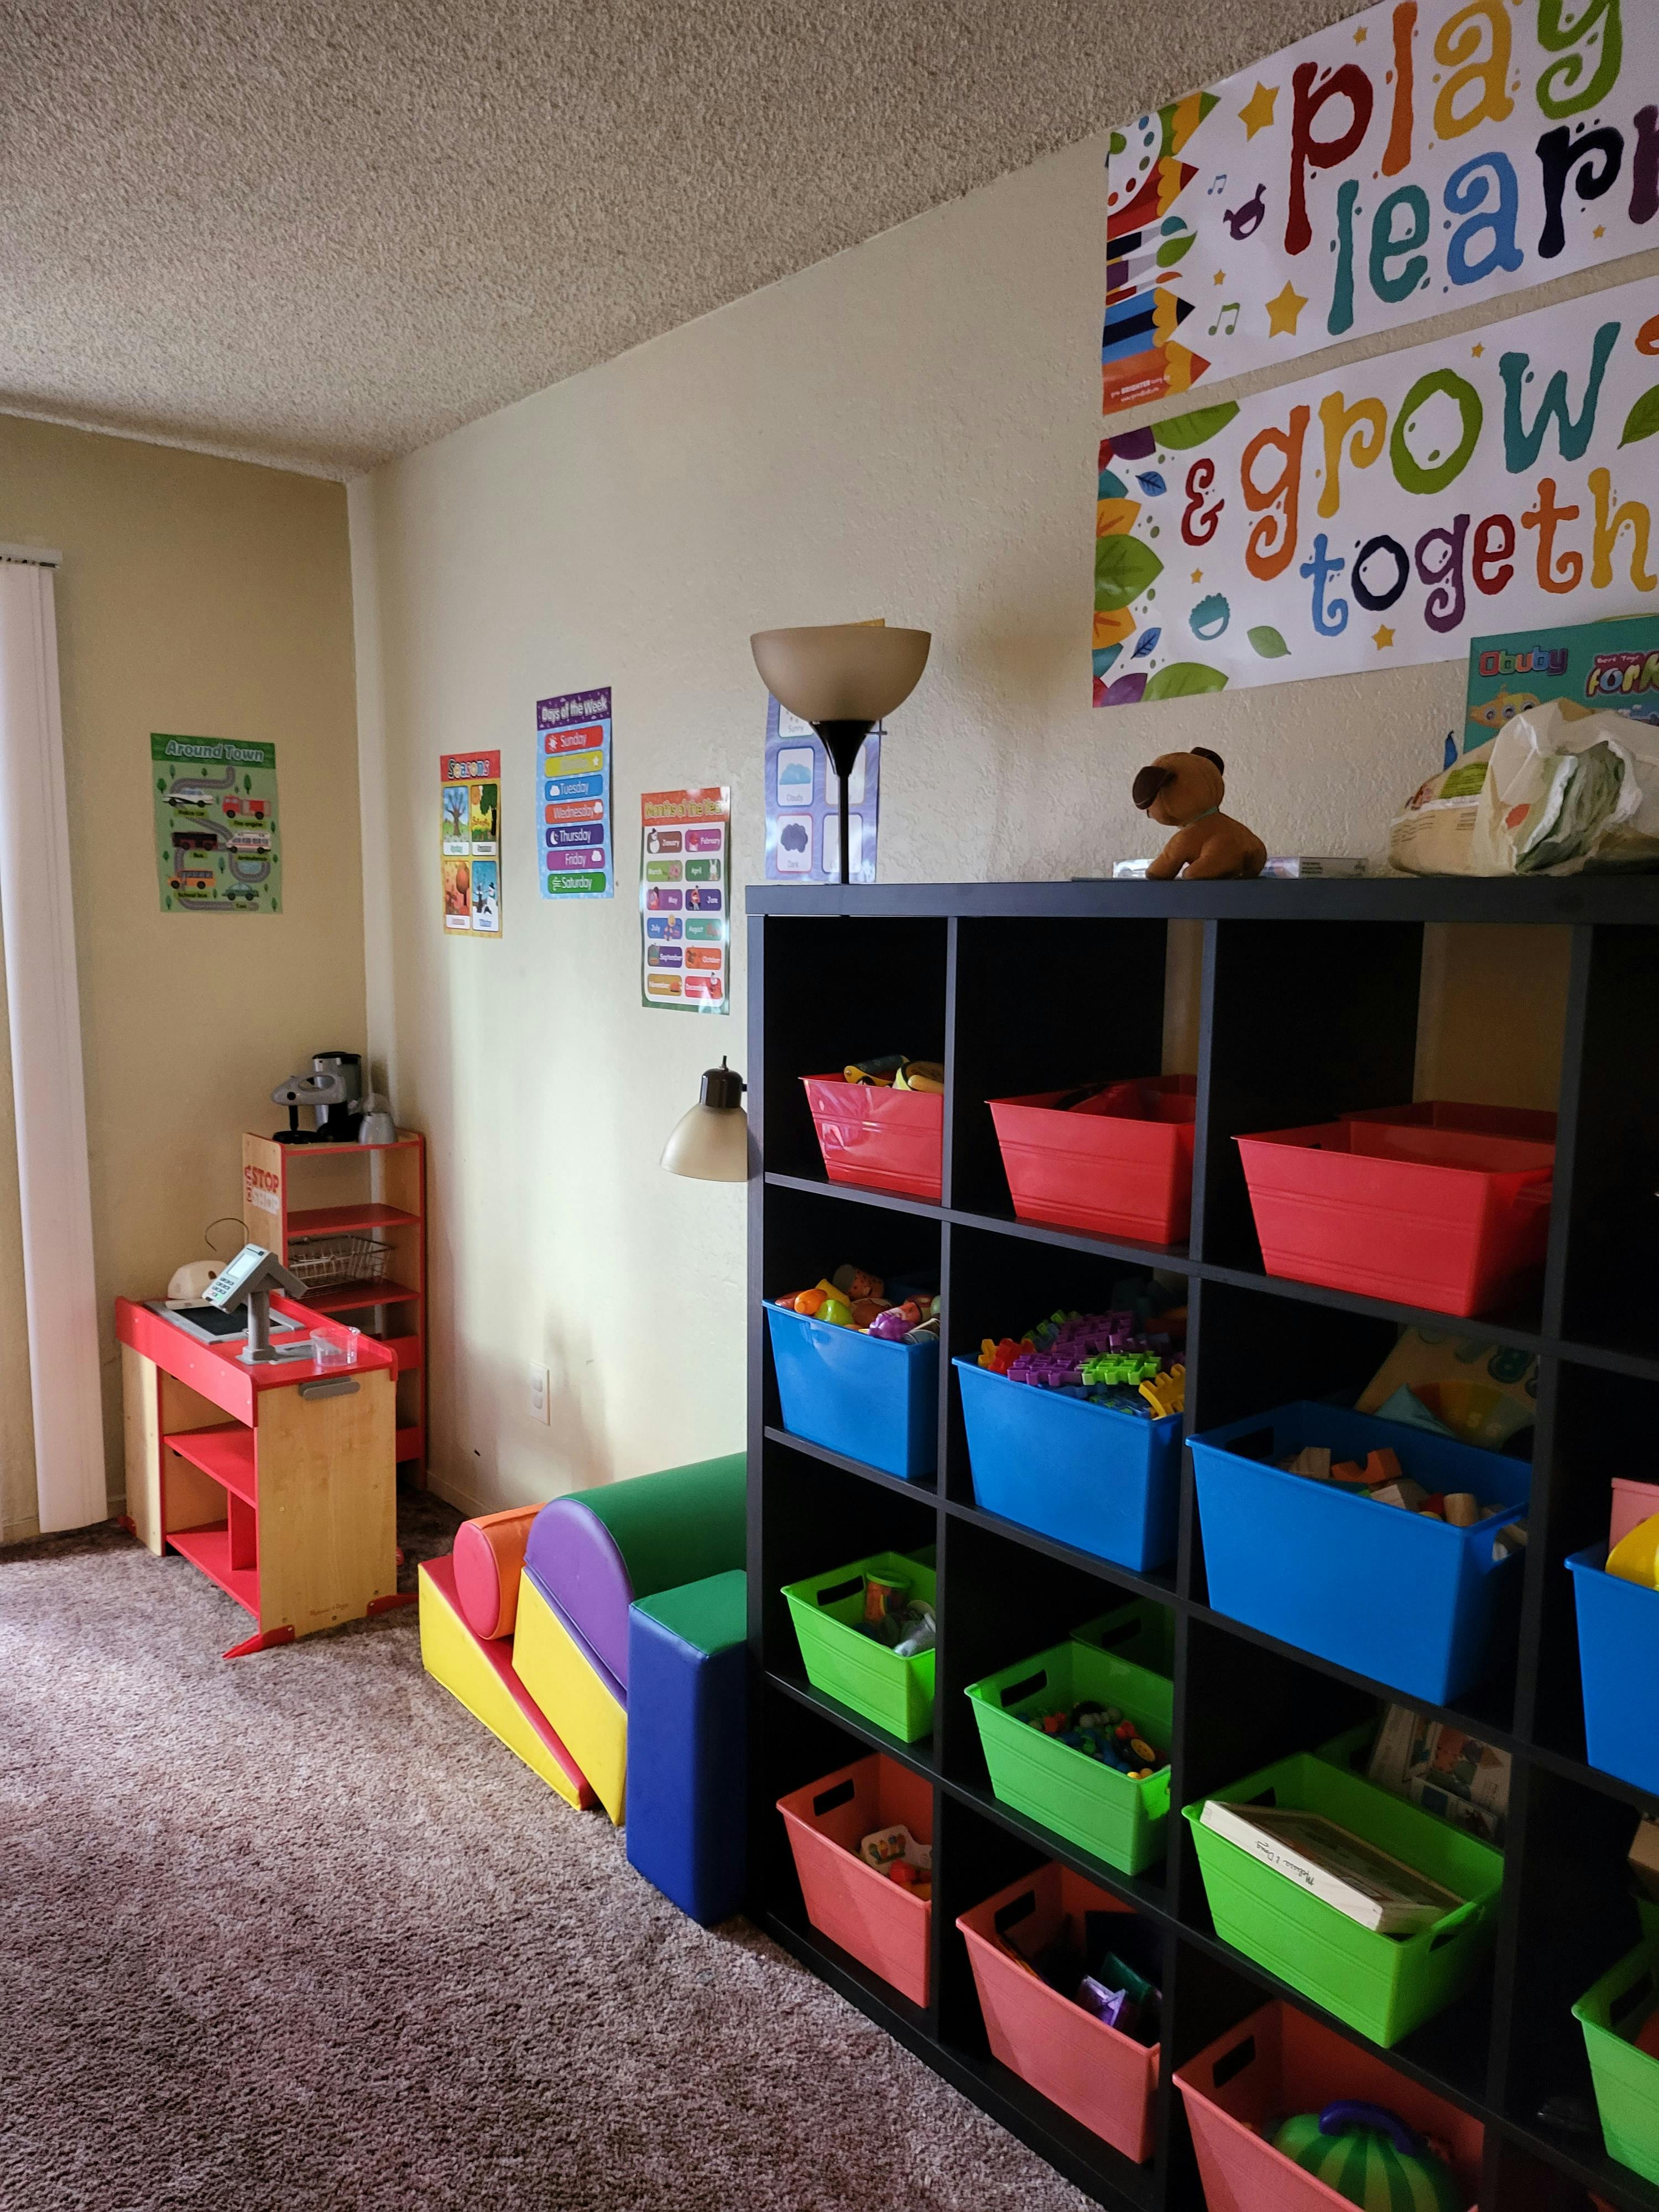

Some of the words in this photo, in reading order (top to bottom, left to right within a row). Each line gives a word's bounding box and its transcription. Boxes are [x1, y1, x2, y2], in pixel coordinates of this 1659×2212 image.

[1285, 0, 1622, 256] play
[1240, 321, 1621, 581] grow
[1300, 467, 1658, 638] togeth
[1478, 645, 1568, 676] Obuby
[541, 706, 560, 724] Days
[561, 701, 569, 719] of
[570, 700, 583, 716] the
[583, 695, 608, 715] Week
[560, 732, 587, 747] Sunday
[165, 739, 223, 759] Around
[224, 744, 264, 763] Town
[447, 758, 490, 779] Seasons
[560, 781, 589, 795] Tuesday
[554, 805, 593, 819] Wednesday
[644, 800, 676, 819] Months
[676, 799, 686, 818] of
[687, 800, 703, 817] the
[559, 828, 591, 843] Thursday
[565, 852, 587, 868] Friday
[561, 876, 593, 890] Saturday
[252, 1166, 279, 1193] STOP
[1255, 1840, 1275, 1861] Doug
